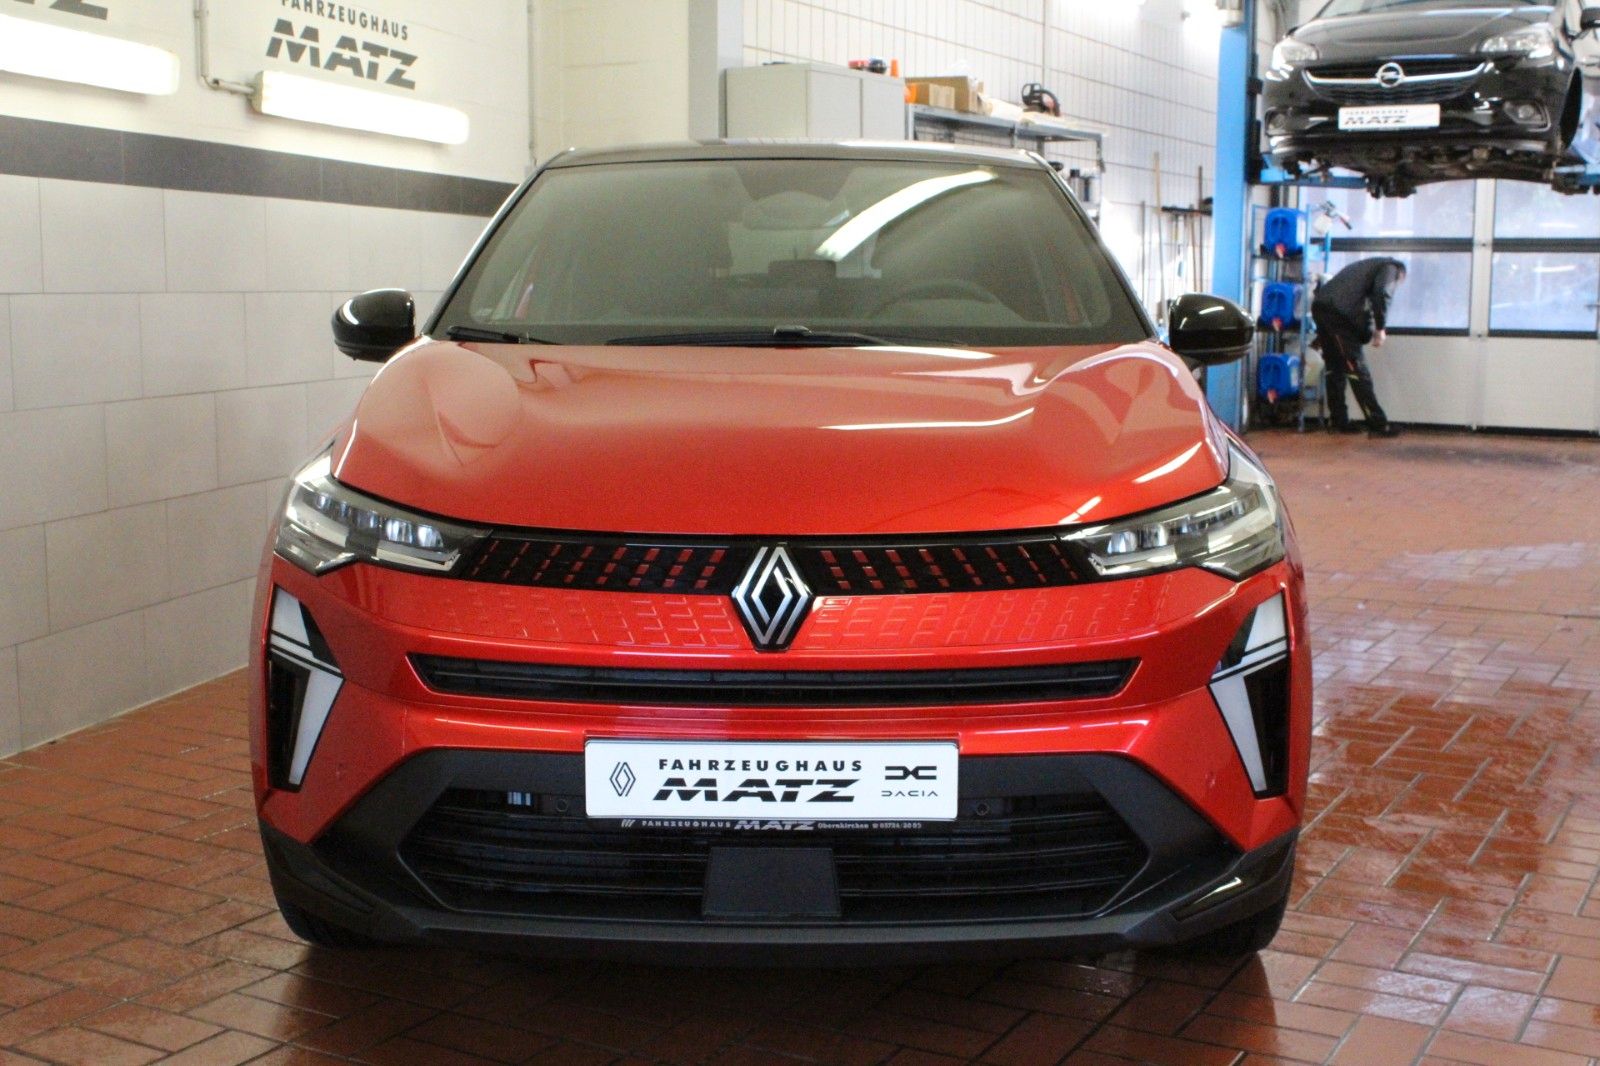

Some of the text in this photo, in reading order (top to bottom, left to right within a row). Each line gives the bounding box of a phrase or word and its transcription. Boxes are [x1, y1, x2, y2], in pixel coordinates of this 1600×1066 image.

[266, 18, 418, 90] MATZ
[659, 759, 862, 772] FAHRZEUGHAUS
[652, 777, 860, 803] MATZ
[642, 820, 731, 828] FAHRZEUGHAUS
[734, 820, 815, 831] MATZ
